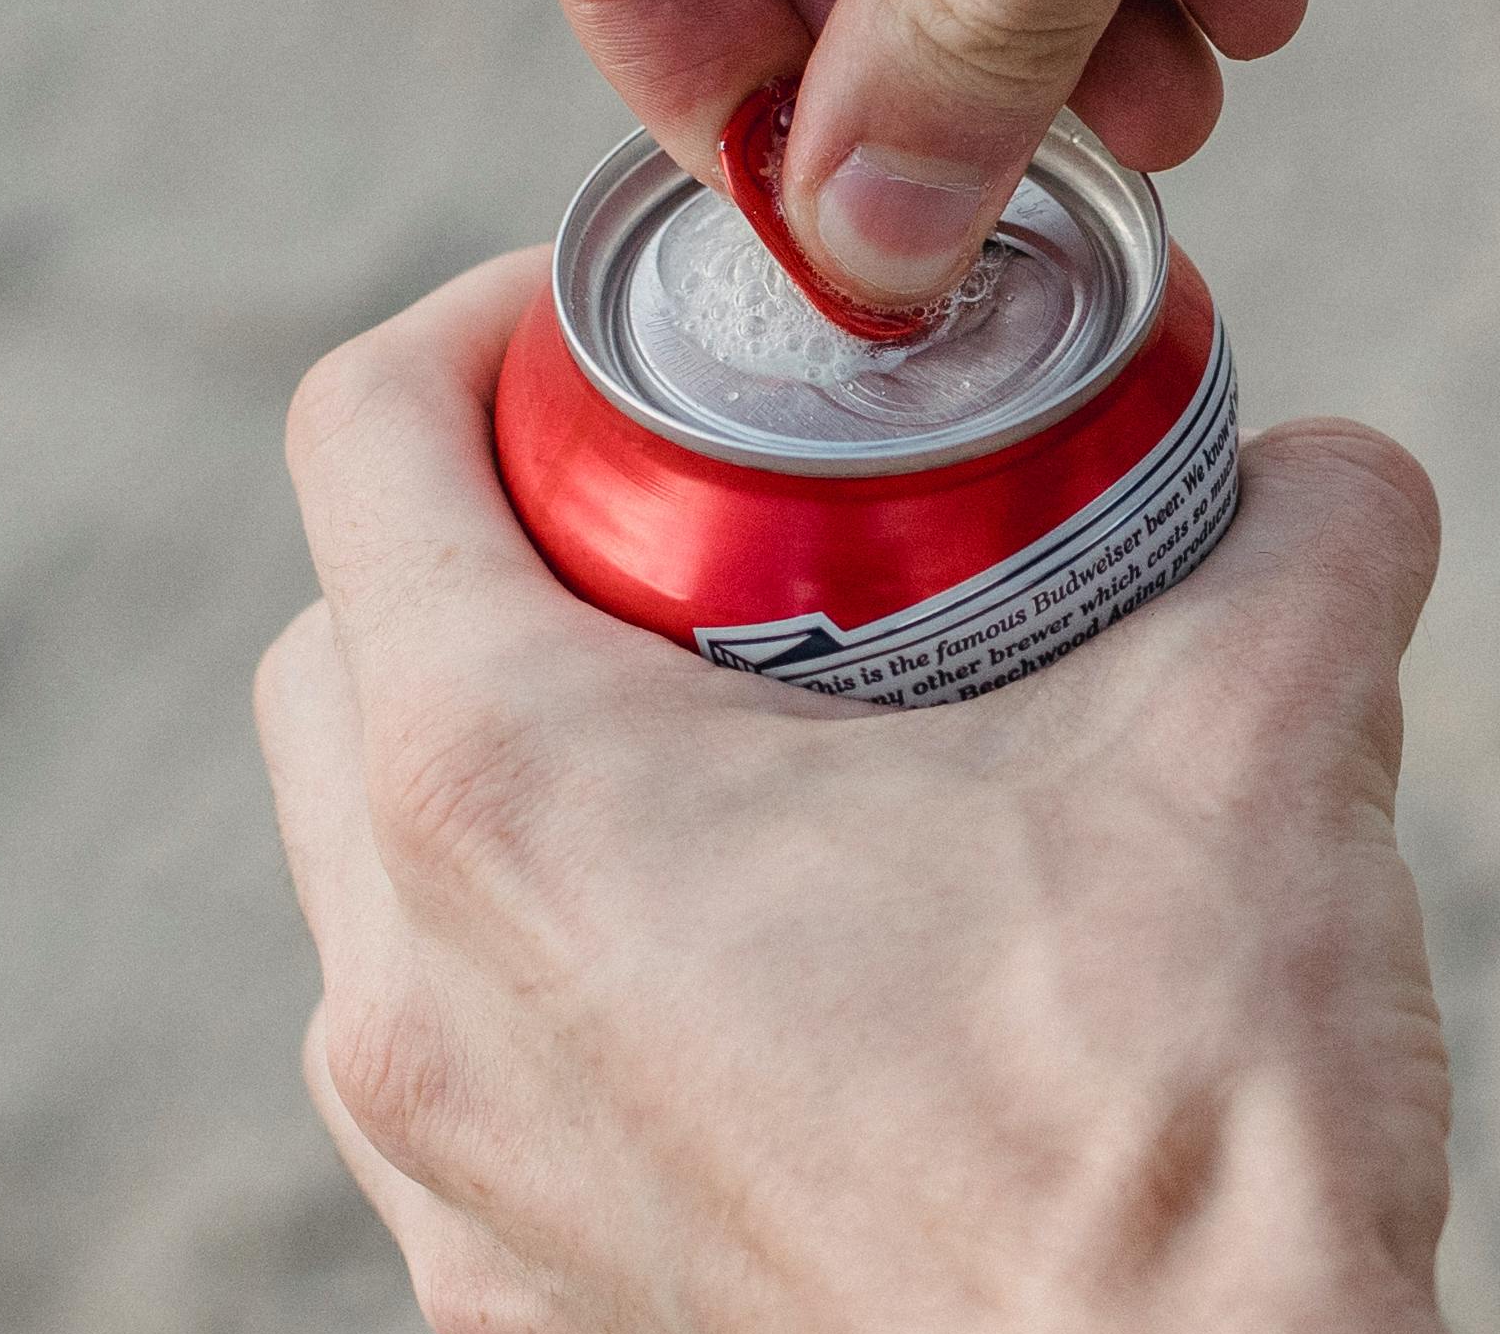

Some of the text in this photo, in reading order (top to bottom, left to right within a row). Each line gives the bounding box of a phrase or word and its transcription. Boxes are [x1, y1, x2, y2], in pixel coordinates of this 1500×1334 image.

[860, 666, 884, 685] is
[888, 653, 931, 677] the
[936, 609, 1028, 666] famous
[1032, 527, 1143, 617] Budweiser
[1143, 491, 1185, 537] beer.
[1181, 464, 1205, 495] We
[1202, 418, 1230, 471] know
[869, 689, 906, 707] ny
[911, 659, 982, 696] other
[988, 610, 1074, 666] brewer
[1080, 563, 1142, 617] which
[1146, 519, 1191, 569] costs
[1192, 498, 1208, 525] so
[1210, 448, 1235, 503] much
[956, 489, 1232, 701] Beechwood Aging produces
